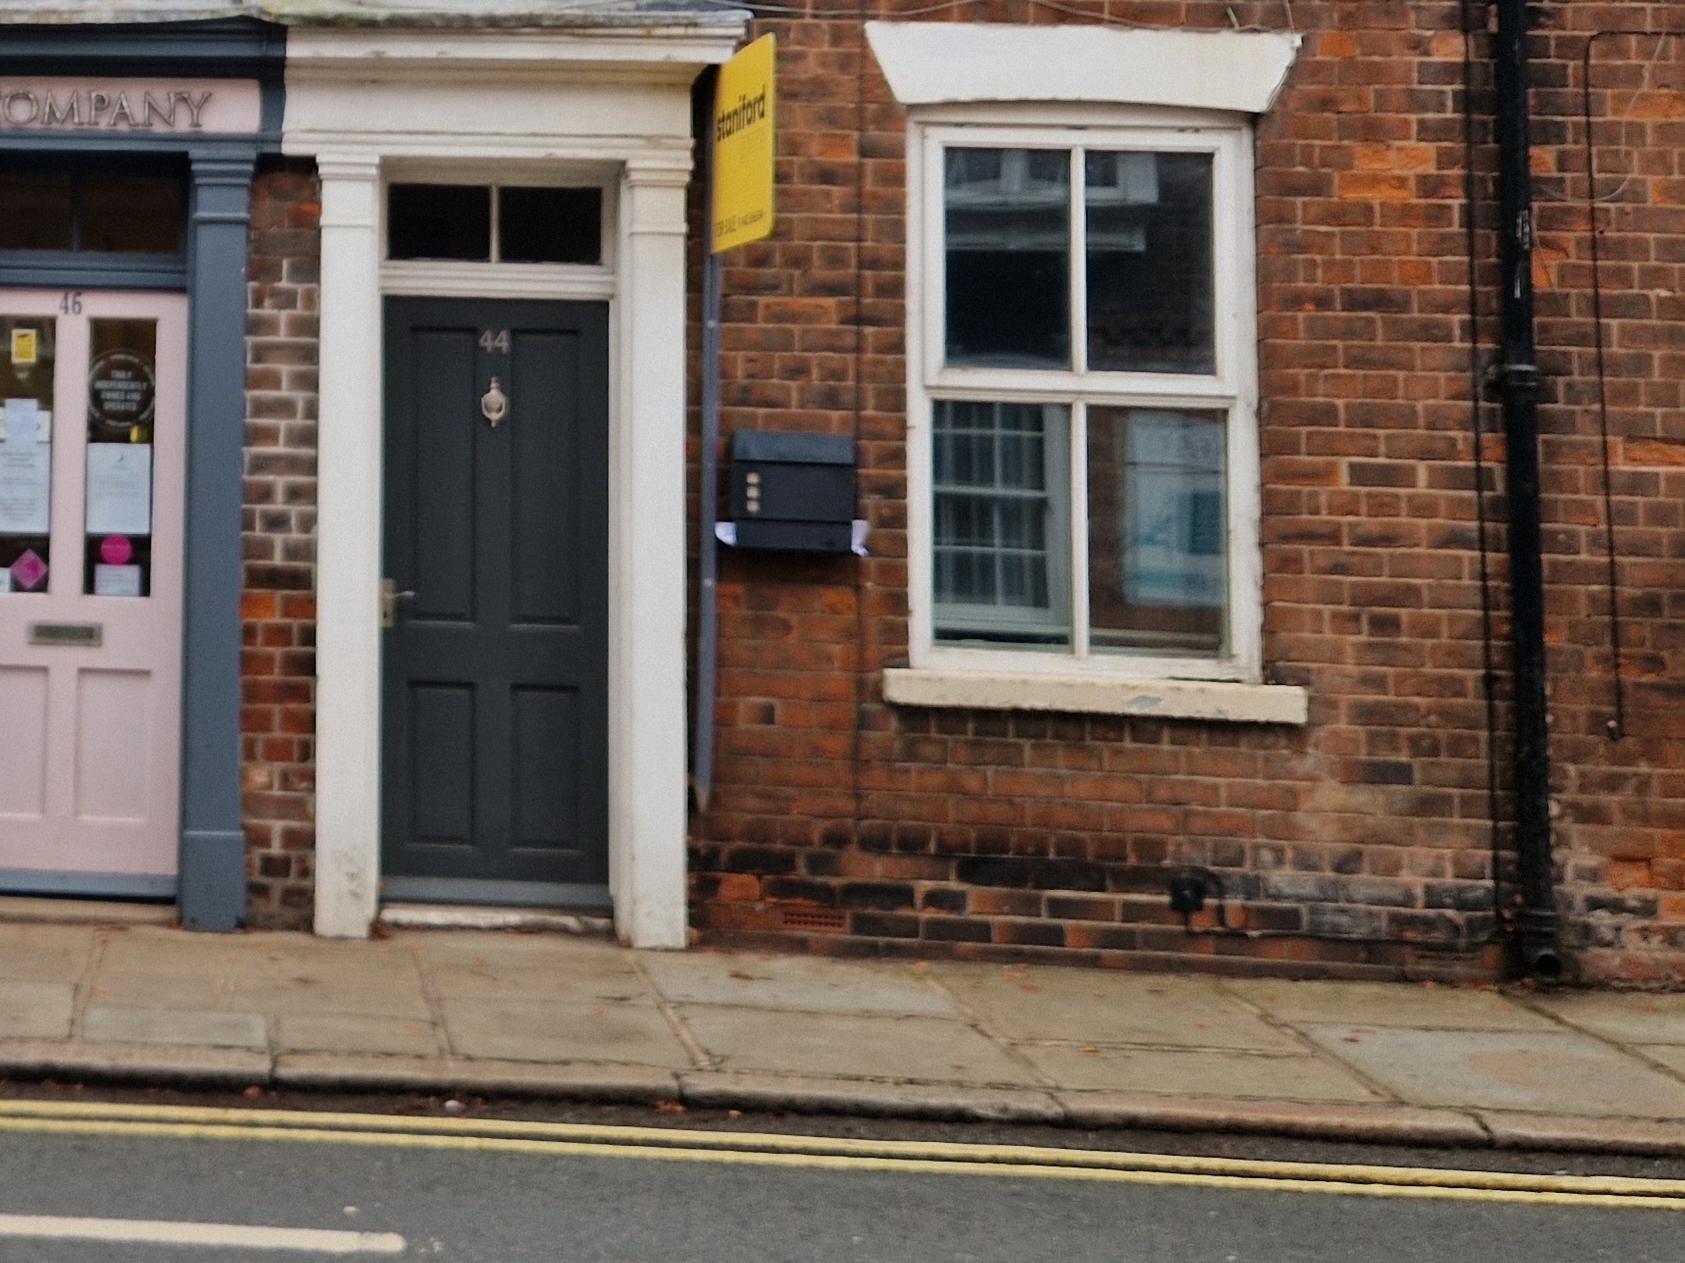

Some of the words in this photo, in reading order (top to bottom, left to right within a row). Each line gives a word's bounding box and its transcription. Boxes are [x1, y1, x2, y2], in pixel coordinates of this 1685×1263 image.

[717, 83, 766, 143] staniford
[59, 290, 82, 315] 46
[478, 329, 511, 354] 44
